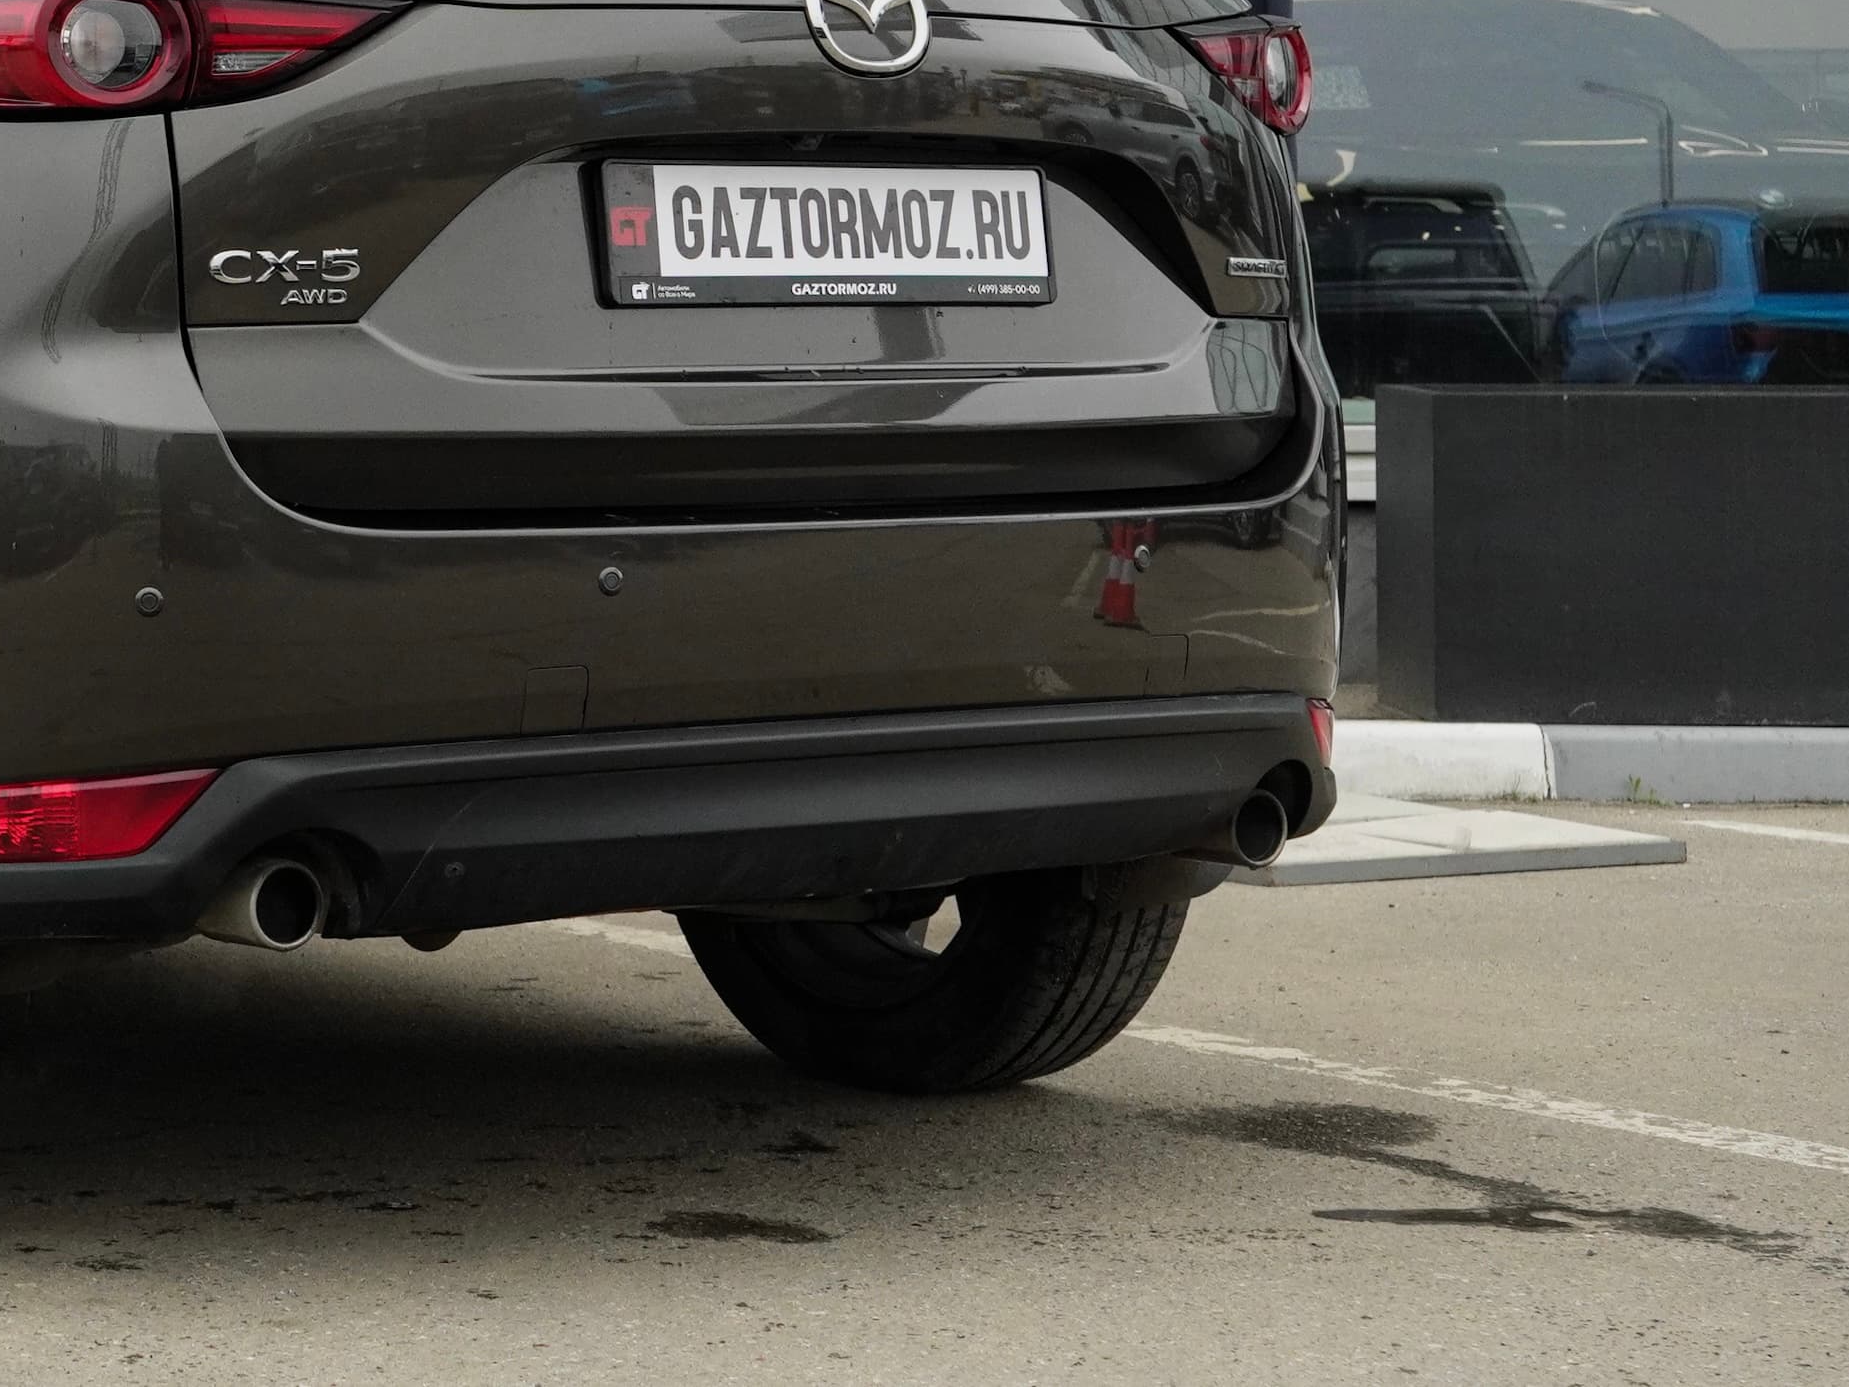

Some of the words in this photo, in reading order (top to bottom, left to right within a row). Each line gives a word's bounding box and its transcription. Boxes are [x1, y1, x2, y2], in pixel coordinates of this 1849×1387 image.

[671, 184, 1031, 260] GAZTORMOZ.RU
[209, 248, 361, 284] CX-5
[280, 288, 348, 306] AWD
[791, 282, 897, 296] GAZTORMOZ.RU
